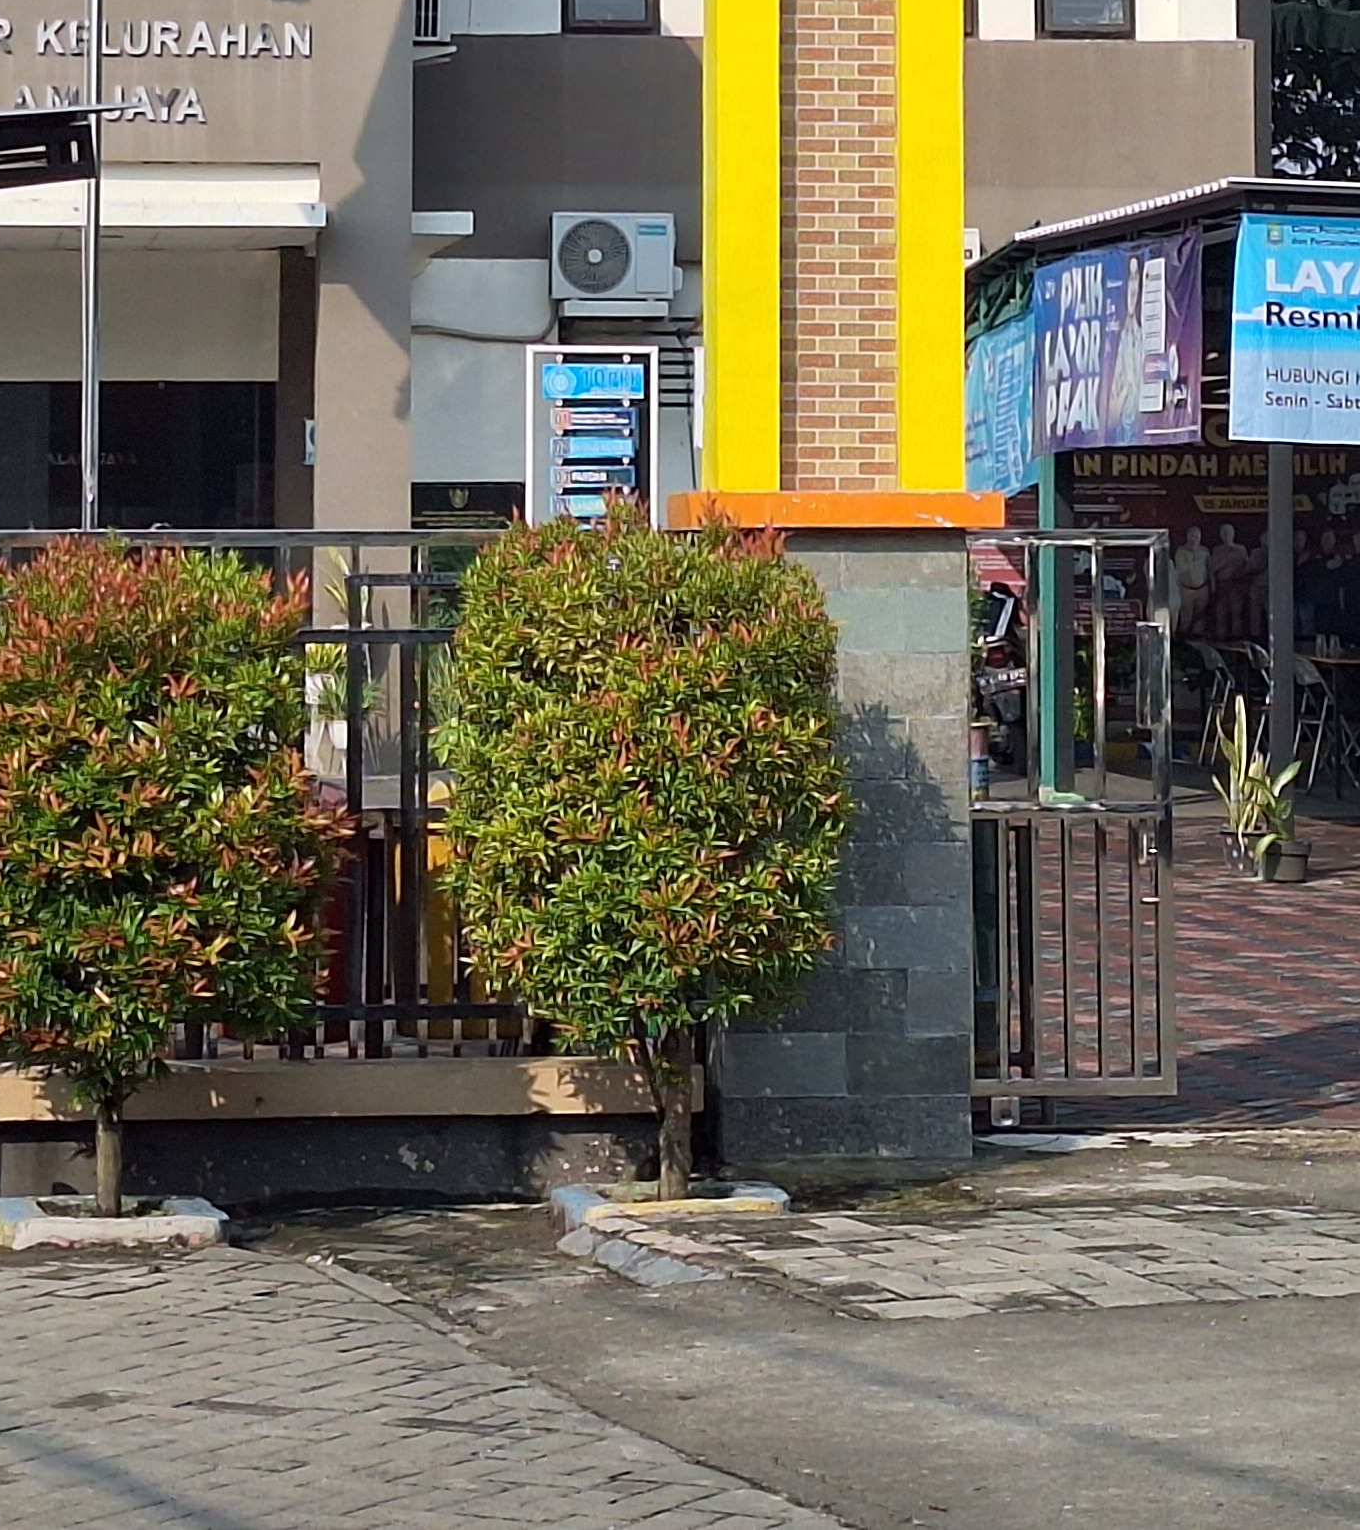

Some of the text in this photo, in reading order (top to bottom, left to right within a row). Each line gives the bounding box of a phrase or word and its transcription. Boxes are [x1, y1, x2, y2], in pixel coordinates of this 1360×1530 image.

[100, 85, 208, 124] JAYA
[1265, 367, 1350, 385] HUBUNGI
[1264, 391, 1309, 408] Senin
[1111, 453, 1219, 478] PINDAH
[1227, 452, 1348, 478] MEILIH
